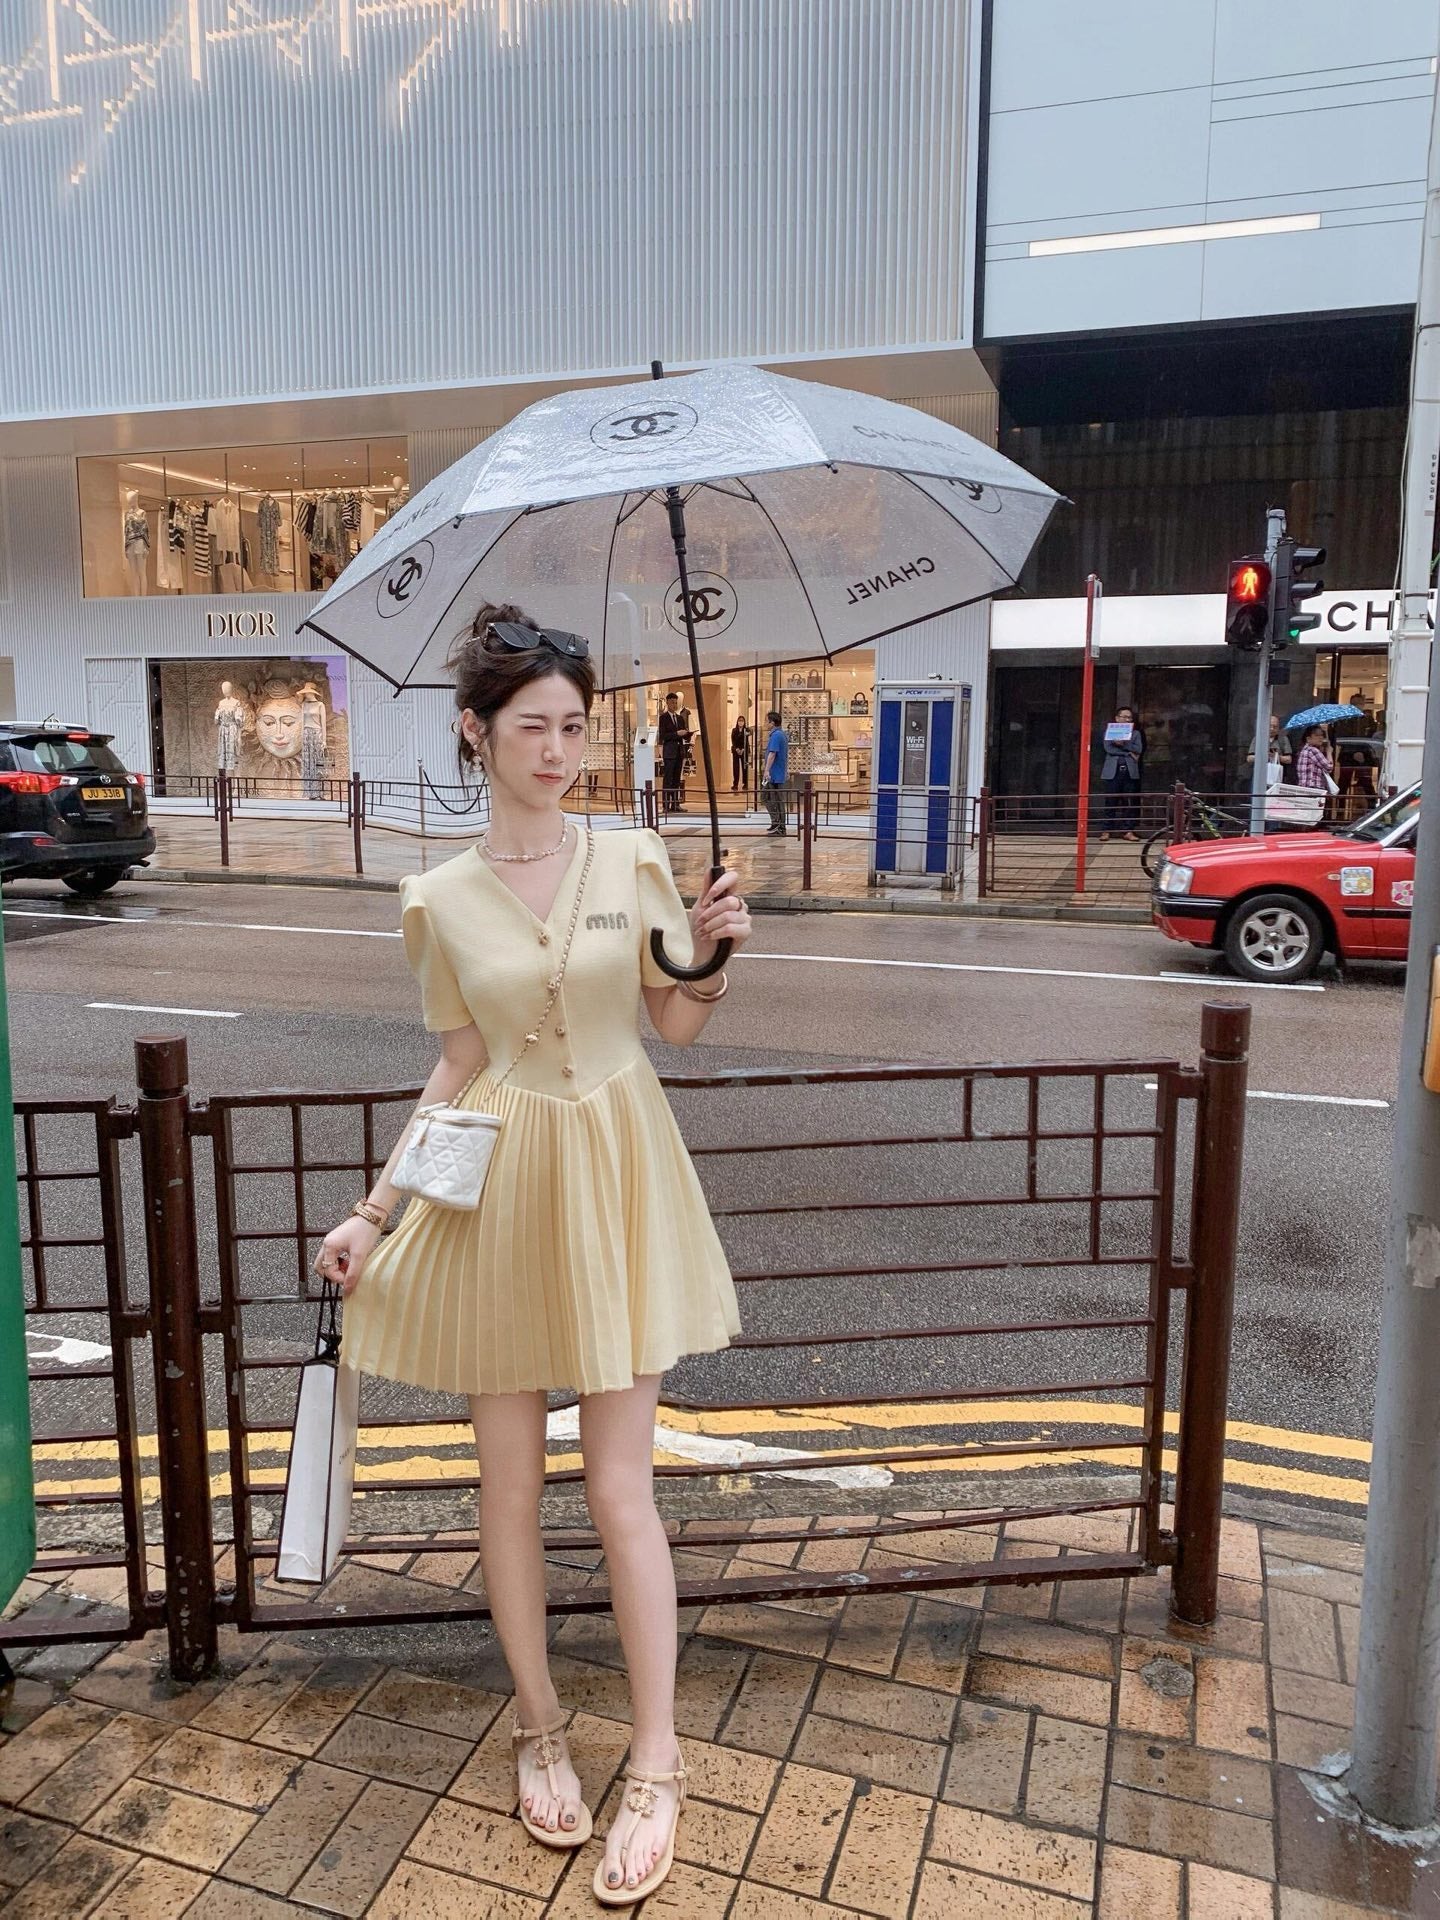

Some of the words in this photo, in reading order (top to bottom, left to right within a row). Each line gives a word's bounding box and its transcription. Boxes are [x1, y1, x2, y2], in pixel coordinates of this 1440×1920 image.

[207, 611, 279, 638] DIOR
[1327, 601, 1434, 632] CH
[906, 736, 925, 744] Wi-Fi
[88, 788, 99, 799] JU
[103, 788, 121, 798] 3318
